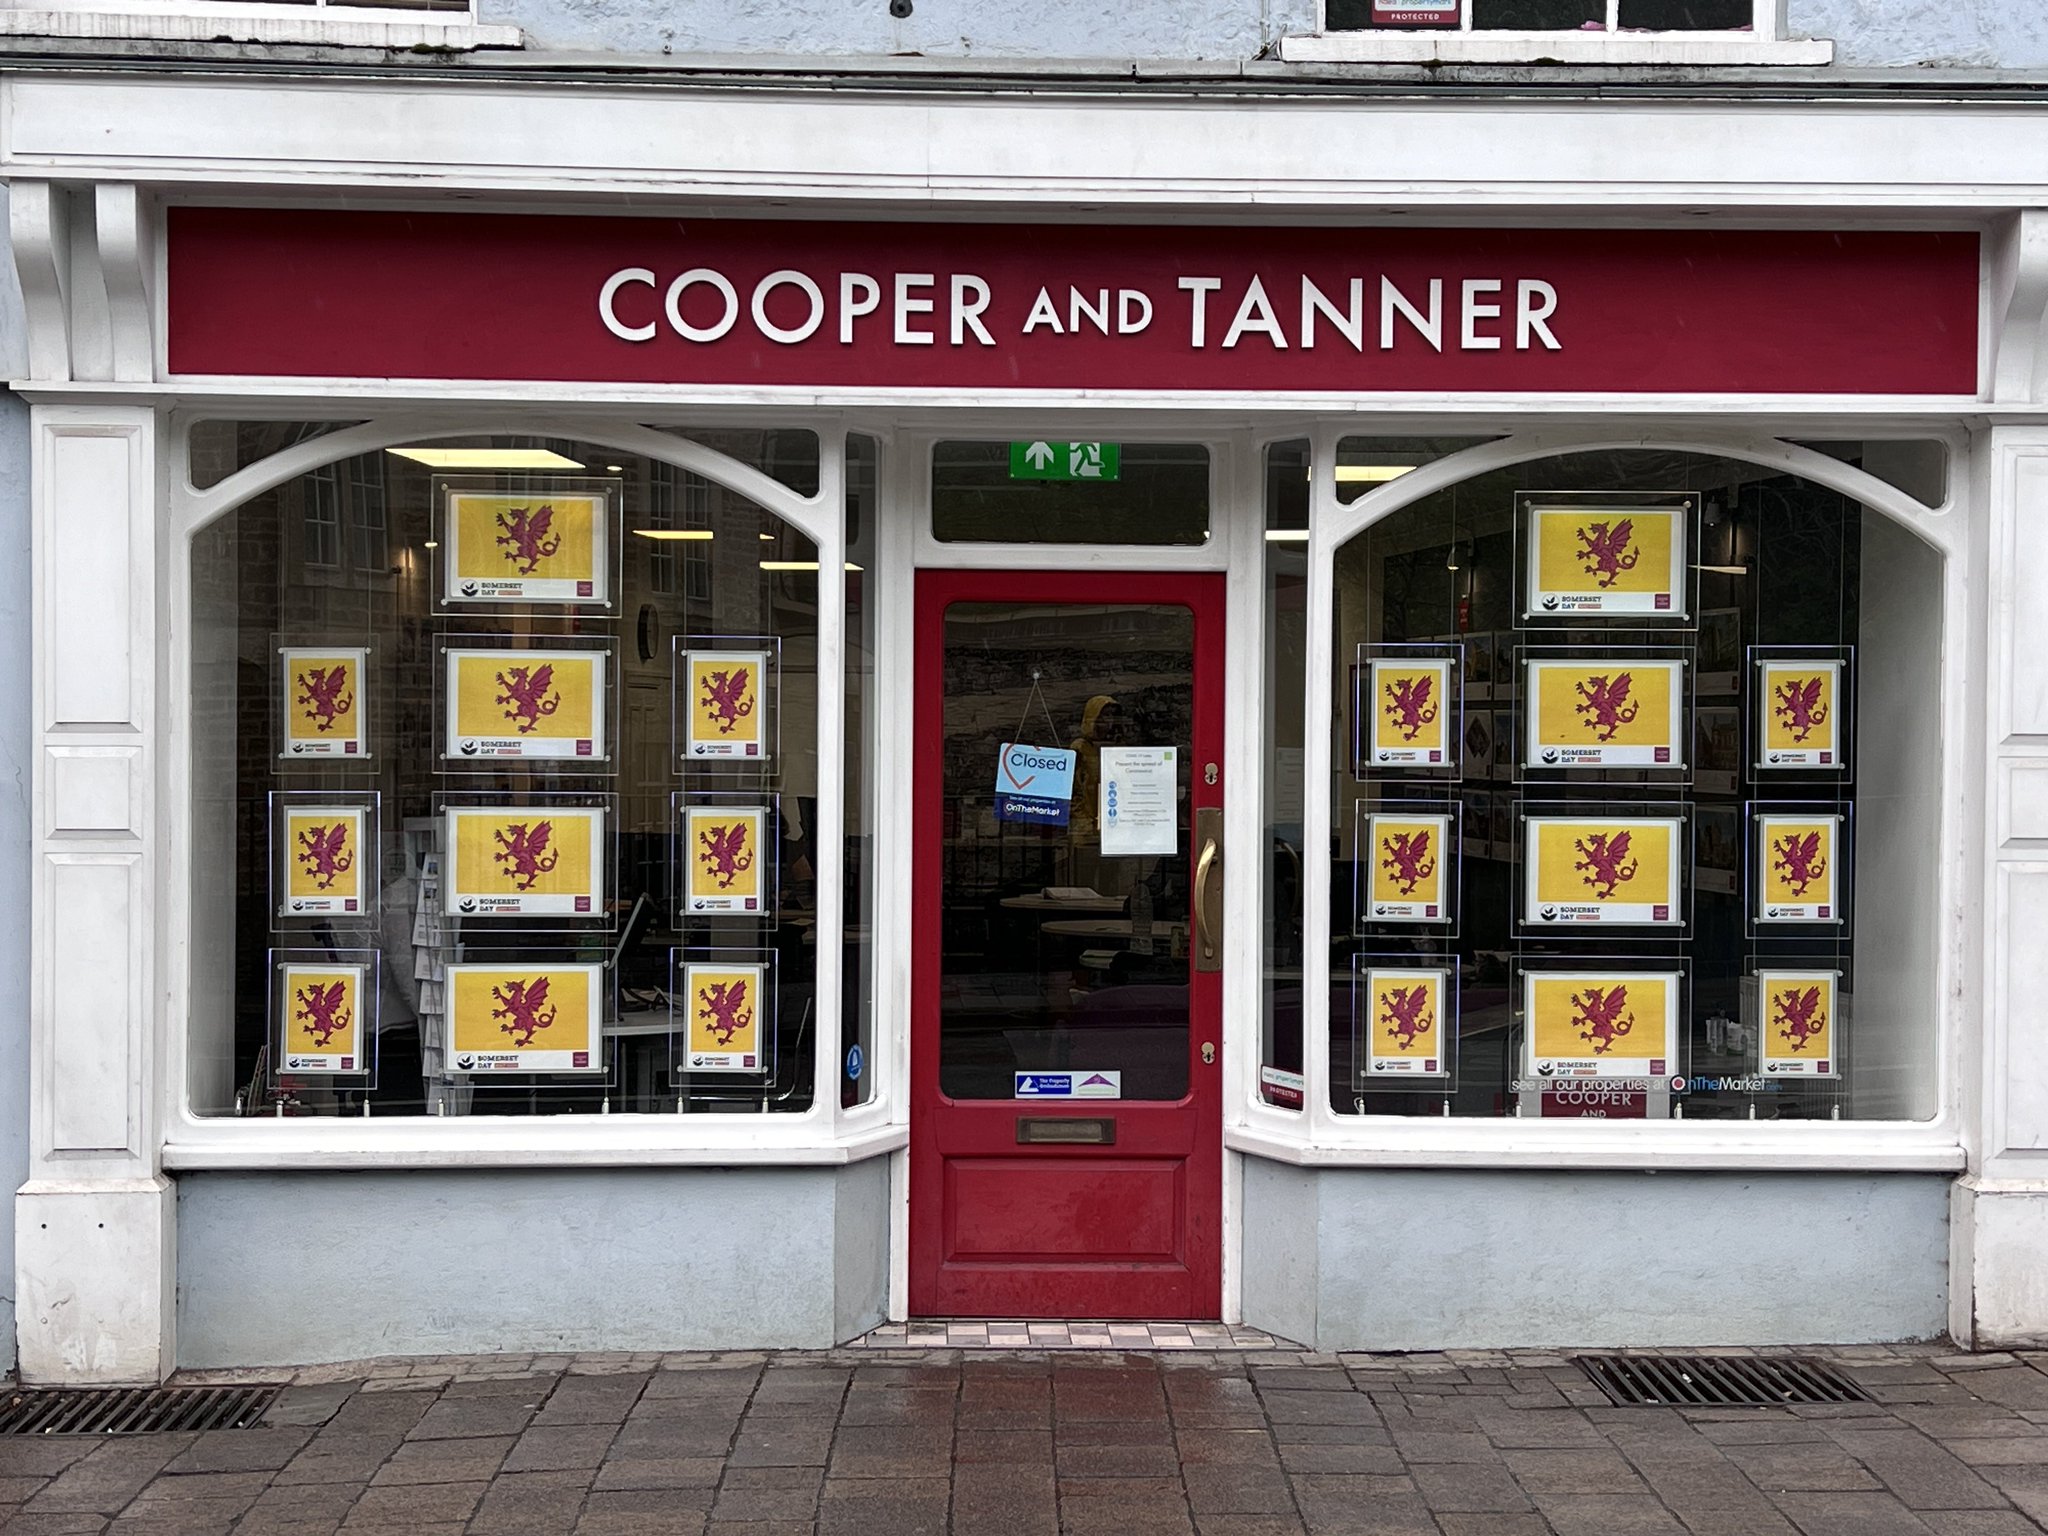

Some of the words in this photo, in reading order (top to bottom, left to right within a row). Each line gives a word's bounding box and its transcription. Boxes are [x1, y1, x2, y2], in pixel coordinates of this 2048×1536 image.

[598, 268, 997, 347] COOPER
[1022, 285, 1154, 336] AND
[1177, 273, 1563, 354] TANNER
[1011, 753, 1068, 772] Closed
[1512, 1080, 1536, 1091] see
[1539, 1078, 1553, 1091] all
[1556, 1080, 1579, 1091] our
[1582, 1078, 1648, 1093] properties
[1653, 1078, 1666, 1091] at
[1556, 1091, 1632, 1106] COOPER
[1581, 1109, 1607, 1118] AND
